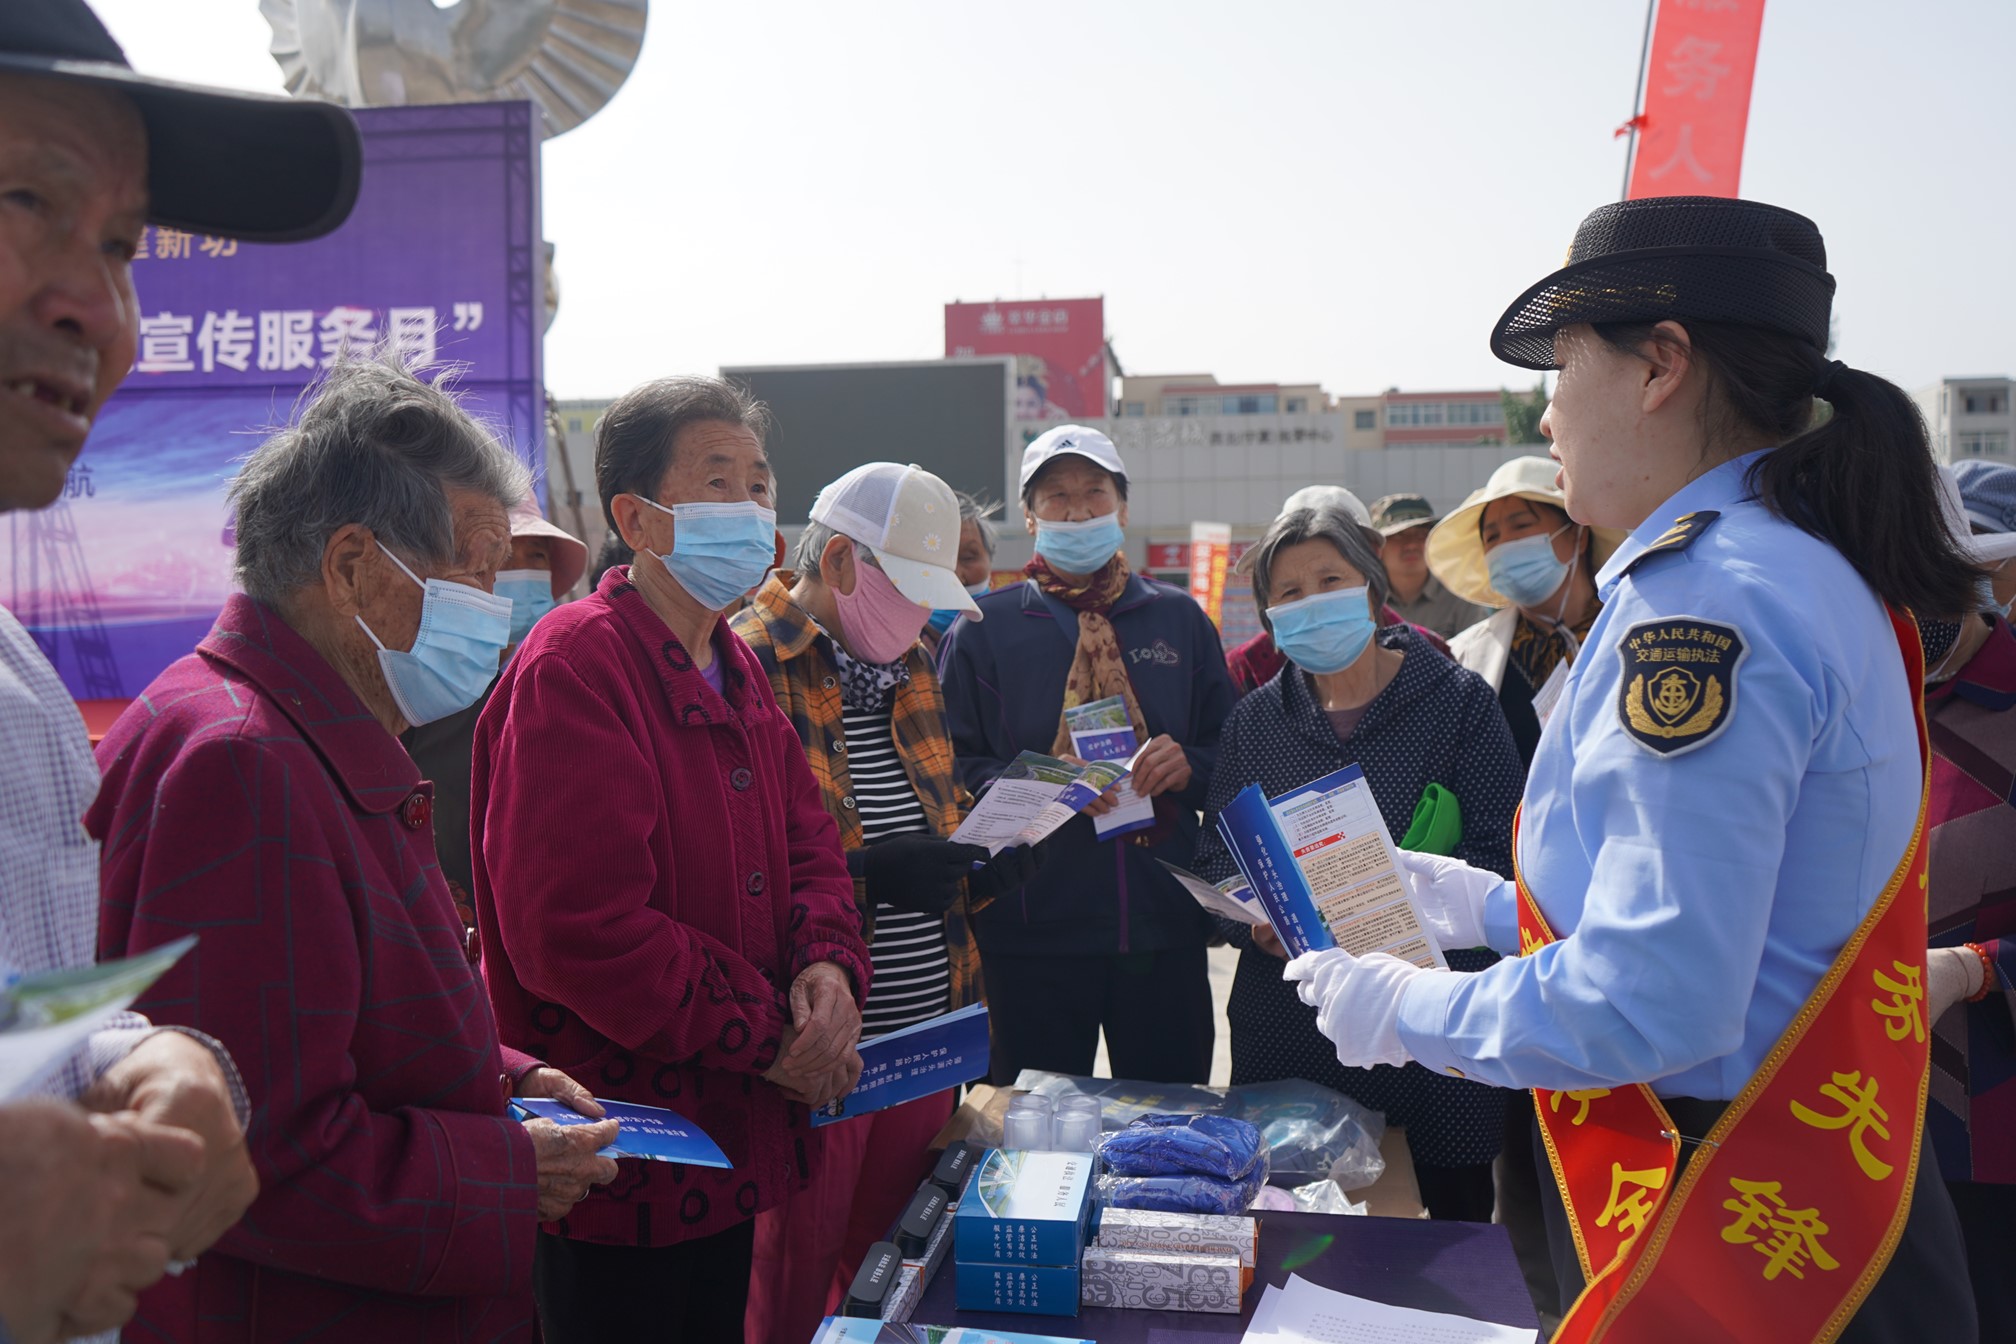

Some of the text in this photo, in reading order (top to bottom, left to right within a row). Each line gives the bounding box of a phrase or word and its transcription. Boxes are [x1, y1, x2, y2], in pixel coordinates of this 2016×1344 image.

[1644, 0, 1742, 185] 务人
[1628, 627, 1733, 651] 中华人民共和国
[1635, 647, 1721, 664] 交通运输执法
[1720, 873, 1930, 1282] 务先锋
